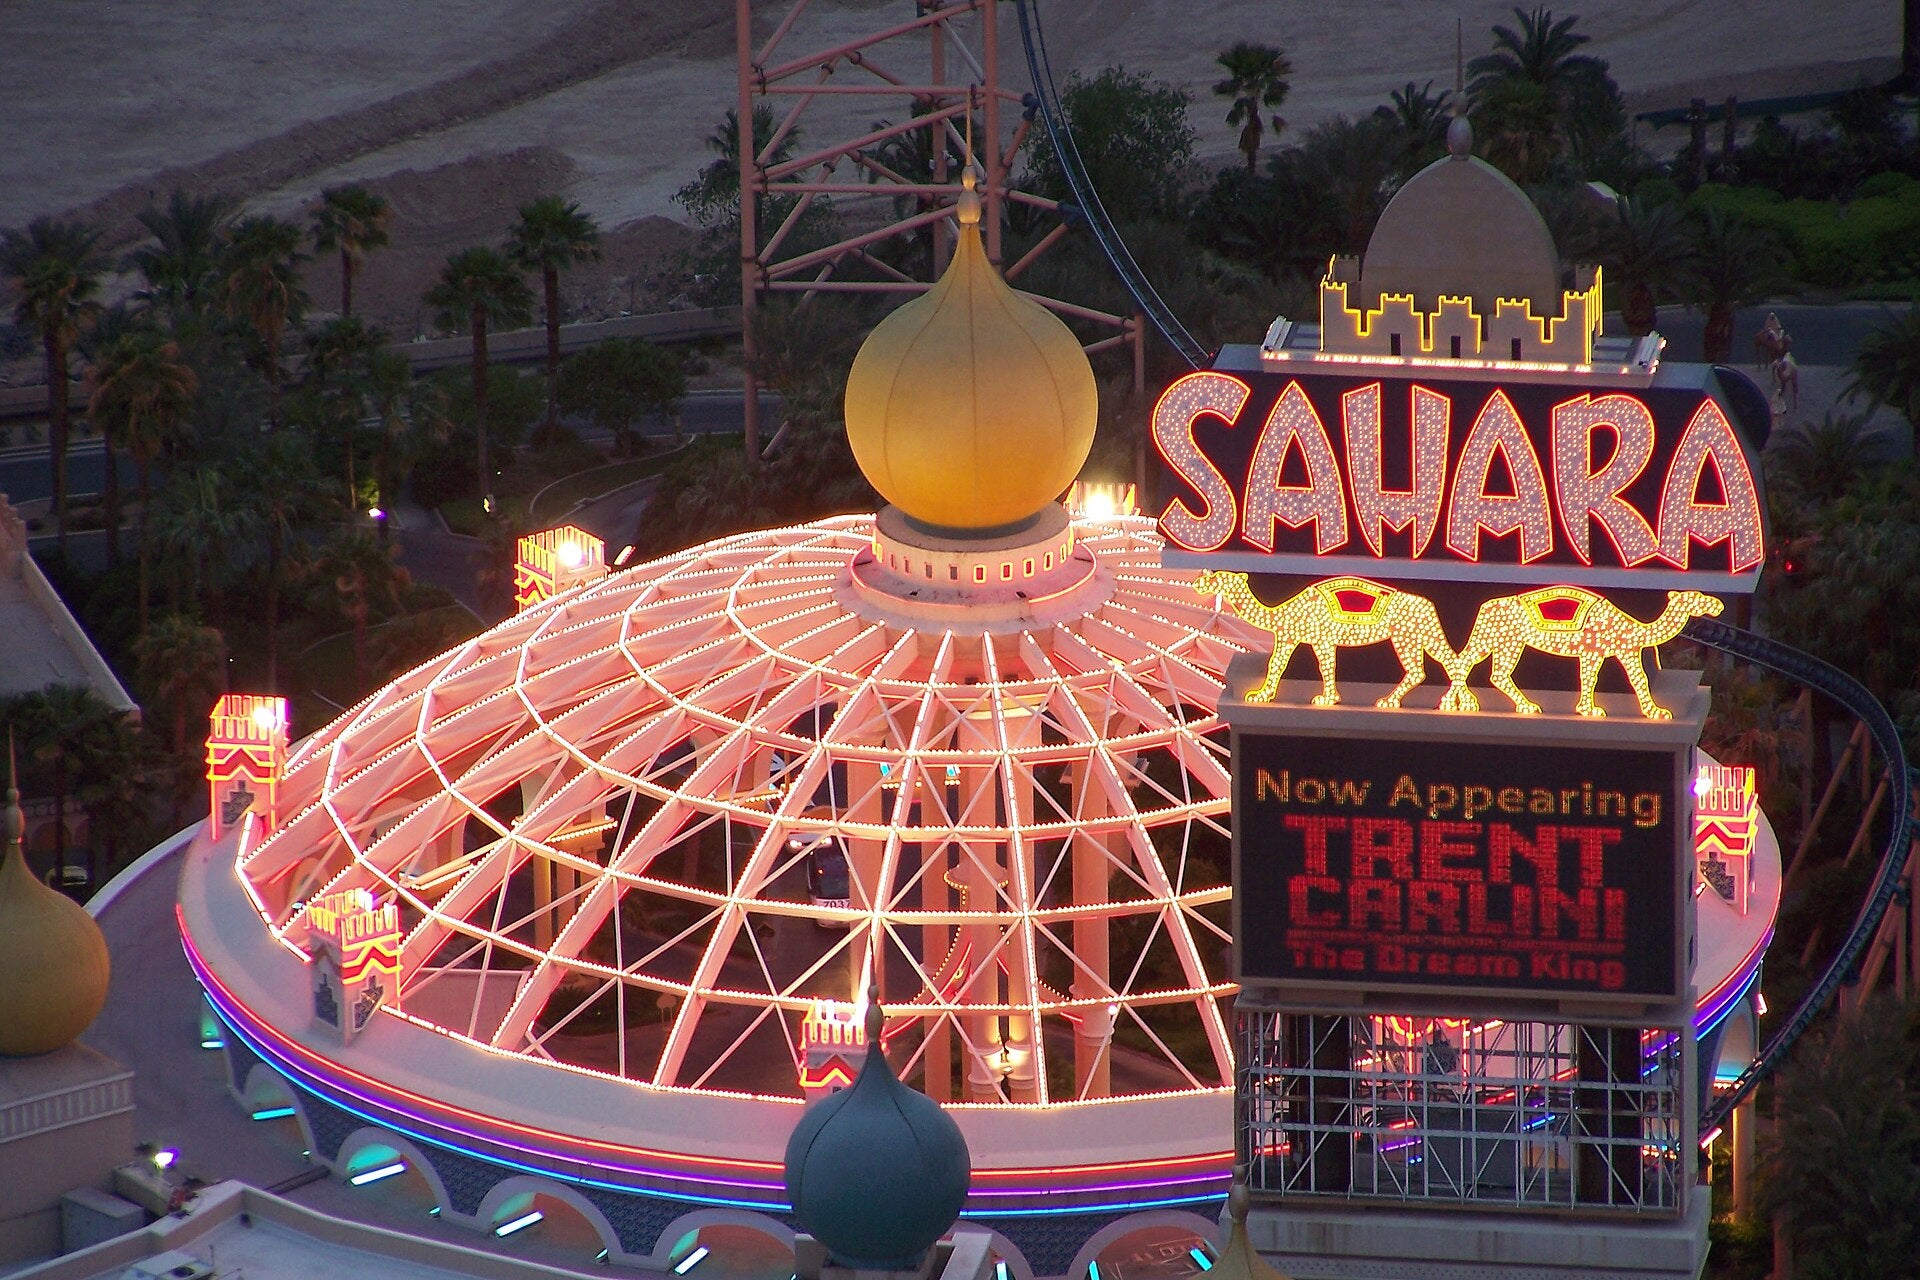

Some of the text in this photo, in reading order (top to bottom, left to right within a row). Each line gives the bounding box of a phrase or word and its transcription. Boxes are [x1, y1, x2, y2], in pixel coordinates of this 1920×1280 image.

[1151, 371, 1766, 574] SAHARA
[1257, 769, 1661, 827] Now Appearing
[1284, 814, 1622, 887] TRENT
[1288, 876, 1626, 939] CARLINI
[1290, 942, 1624, 988] The Dream King
